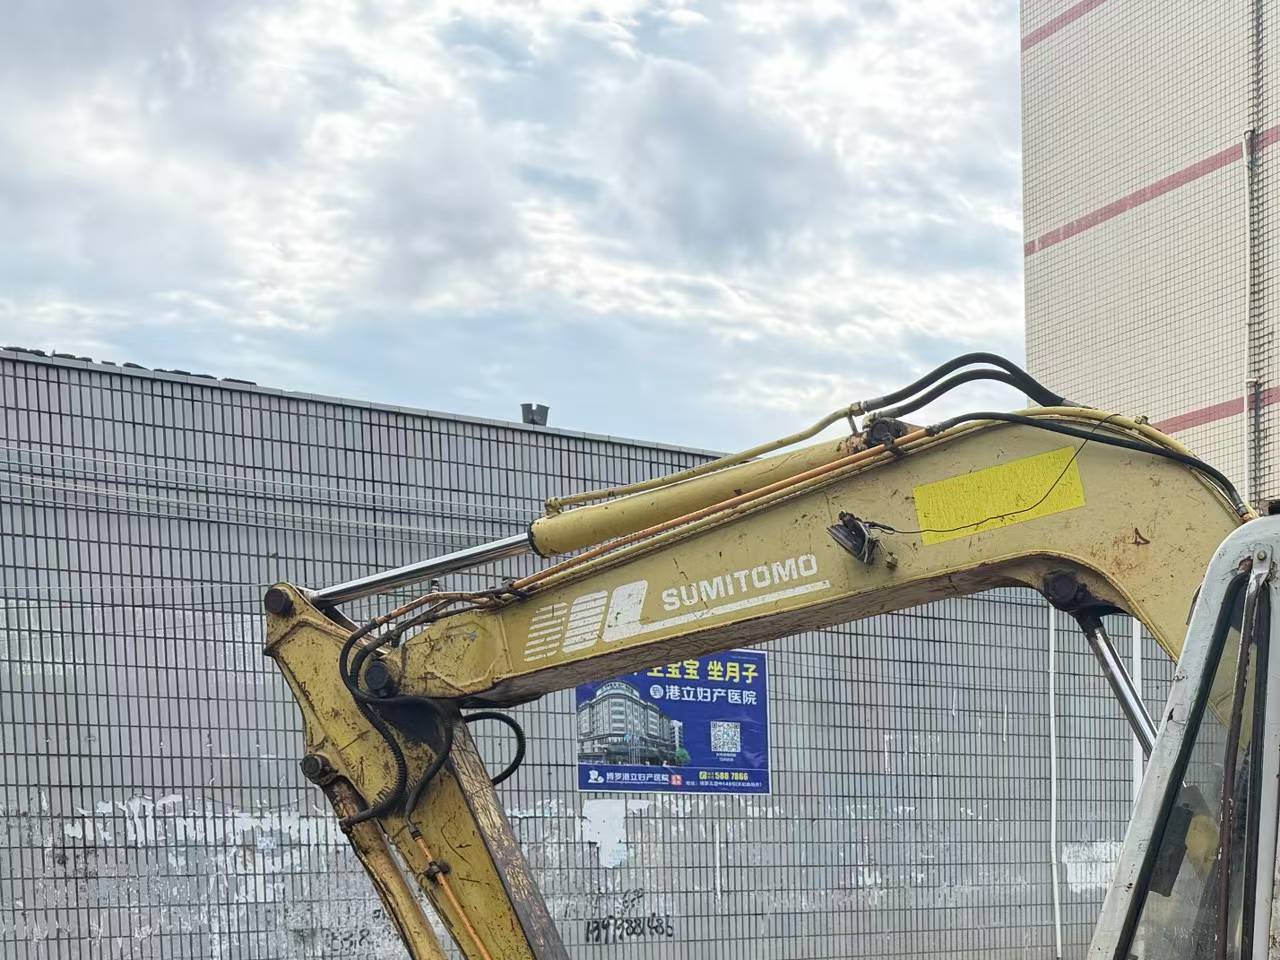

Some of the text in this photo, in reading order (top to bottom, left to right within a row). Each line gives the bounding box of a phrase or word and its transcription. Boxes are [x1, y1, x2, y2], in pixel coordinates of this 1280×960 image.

[662, 554, 818, 611] SUMITOMO
[707, 660, 758, 683] 坐月子
